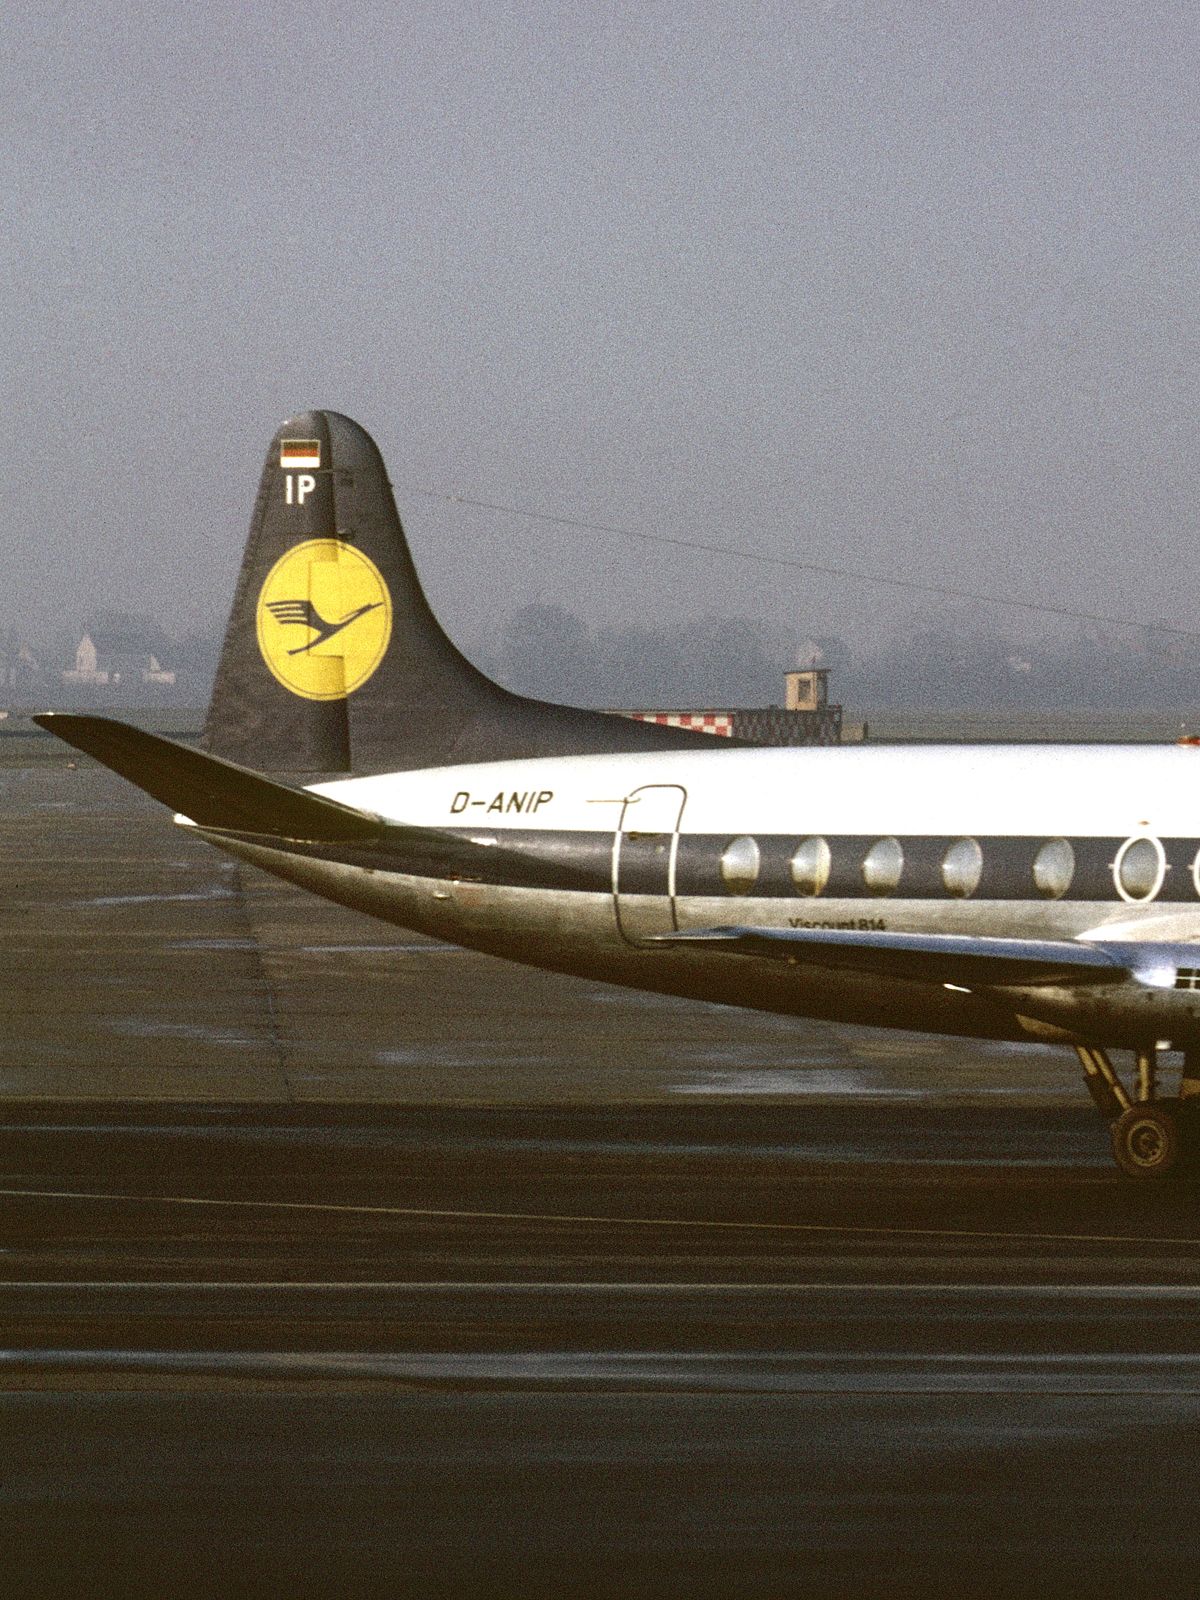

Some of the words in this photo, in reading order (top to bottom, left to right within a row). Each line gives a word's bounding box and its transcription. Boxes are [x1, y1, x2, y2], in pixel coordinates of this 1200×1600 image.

[286, 474, 316, 504] IP
[450, 791, 554, 813] D-ANIP
[858, 918, 886, 931] 814
